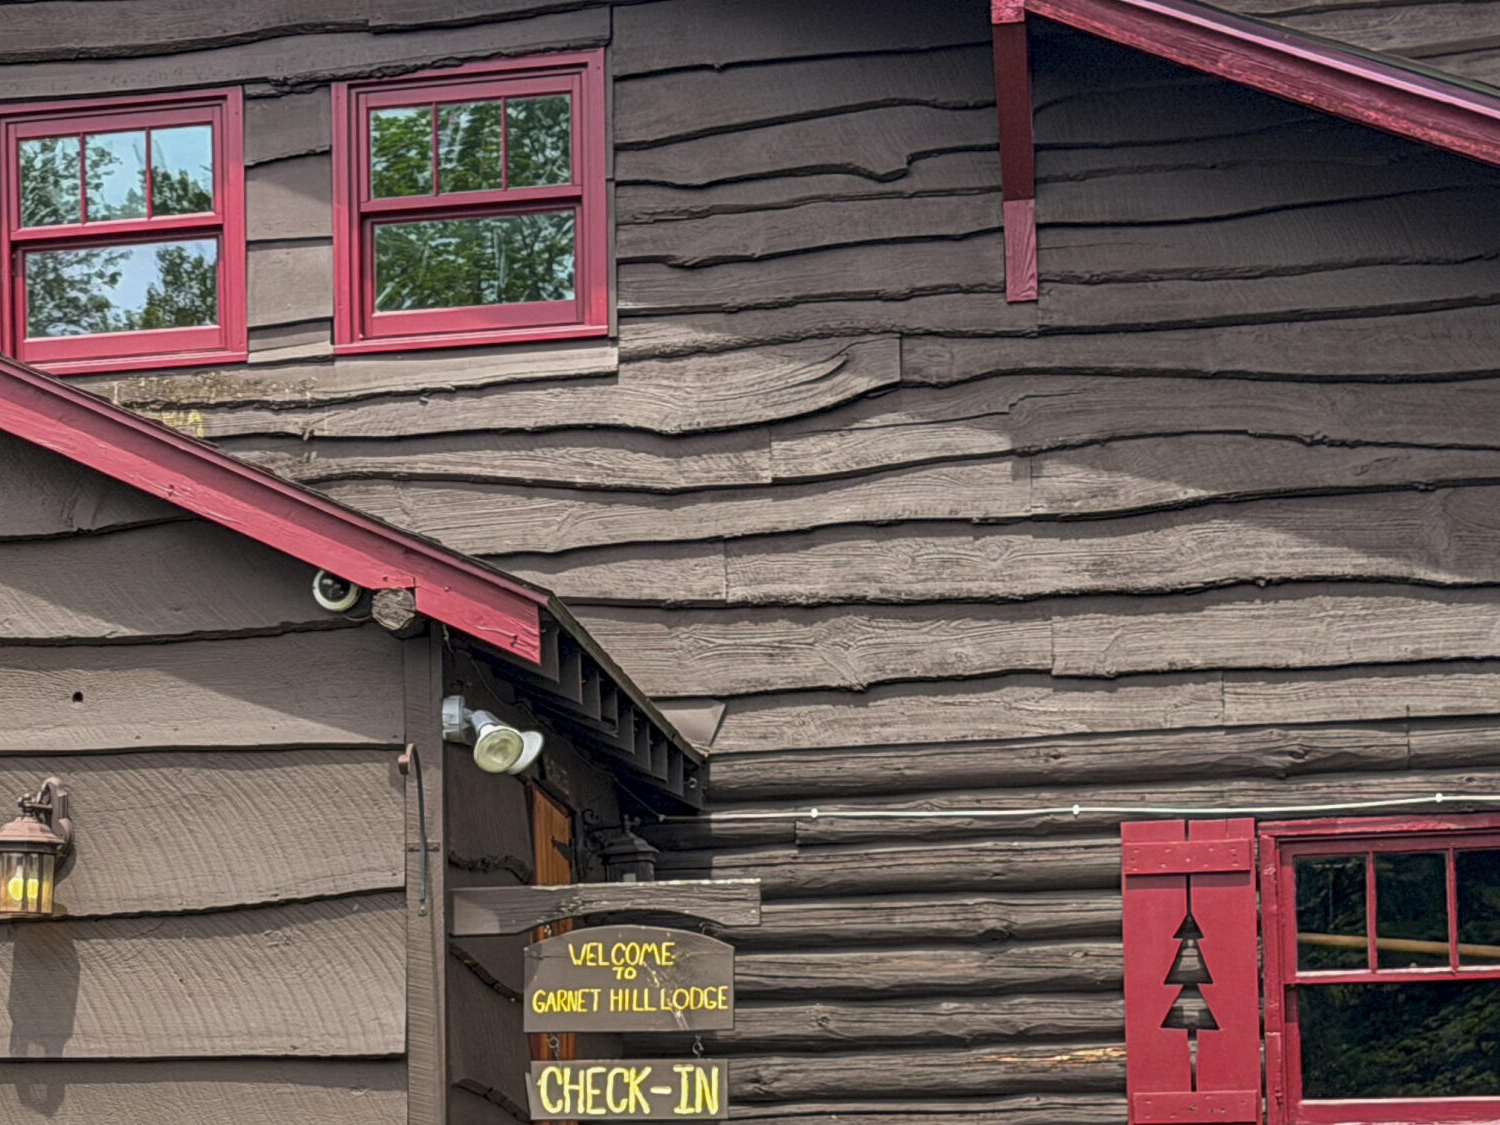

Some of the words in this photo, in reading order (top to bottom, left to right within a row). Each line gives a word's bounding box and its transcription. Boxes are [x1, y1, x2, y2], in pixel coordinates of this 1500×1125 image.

[568, 942, 676, 966] WELCOME
[612, 966, 637, 980] TO
[532, 988, 602, 1013] GARNET
[609, 988, 657, 1012] HILL
[660, 986, 729, 1011] LODGE
[538, 1064, 719, 1115] CHECK-IN
